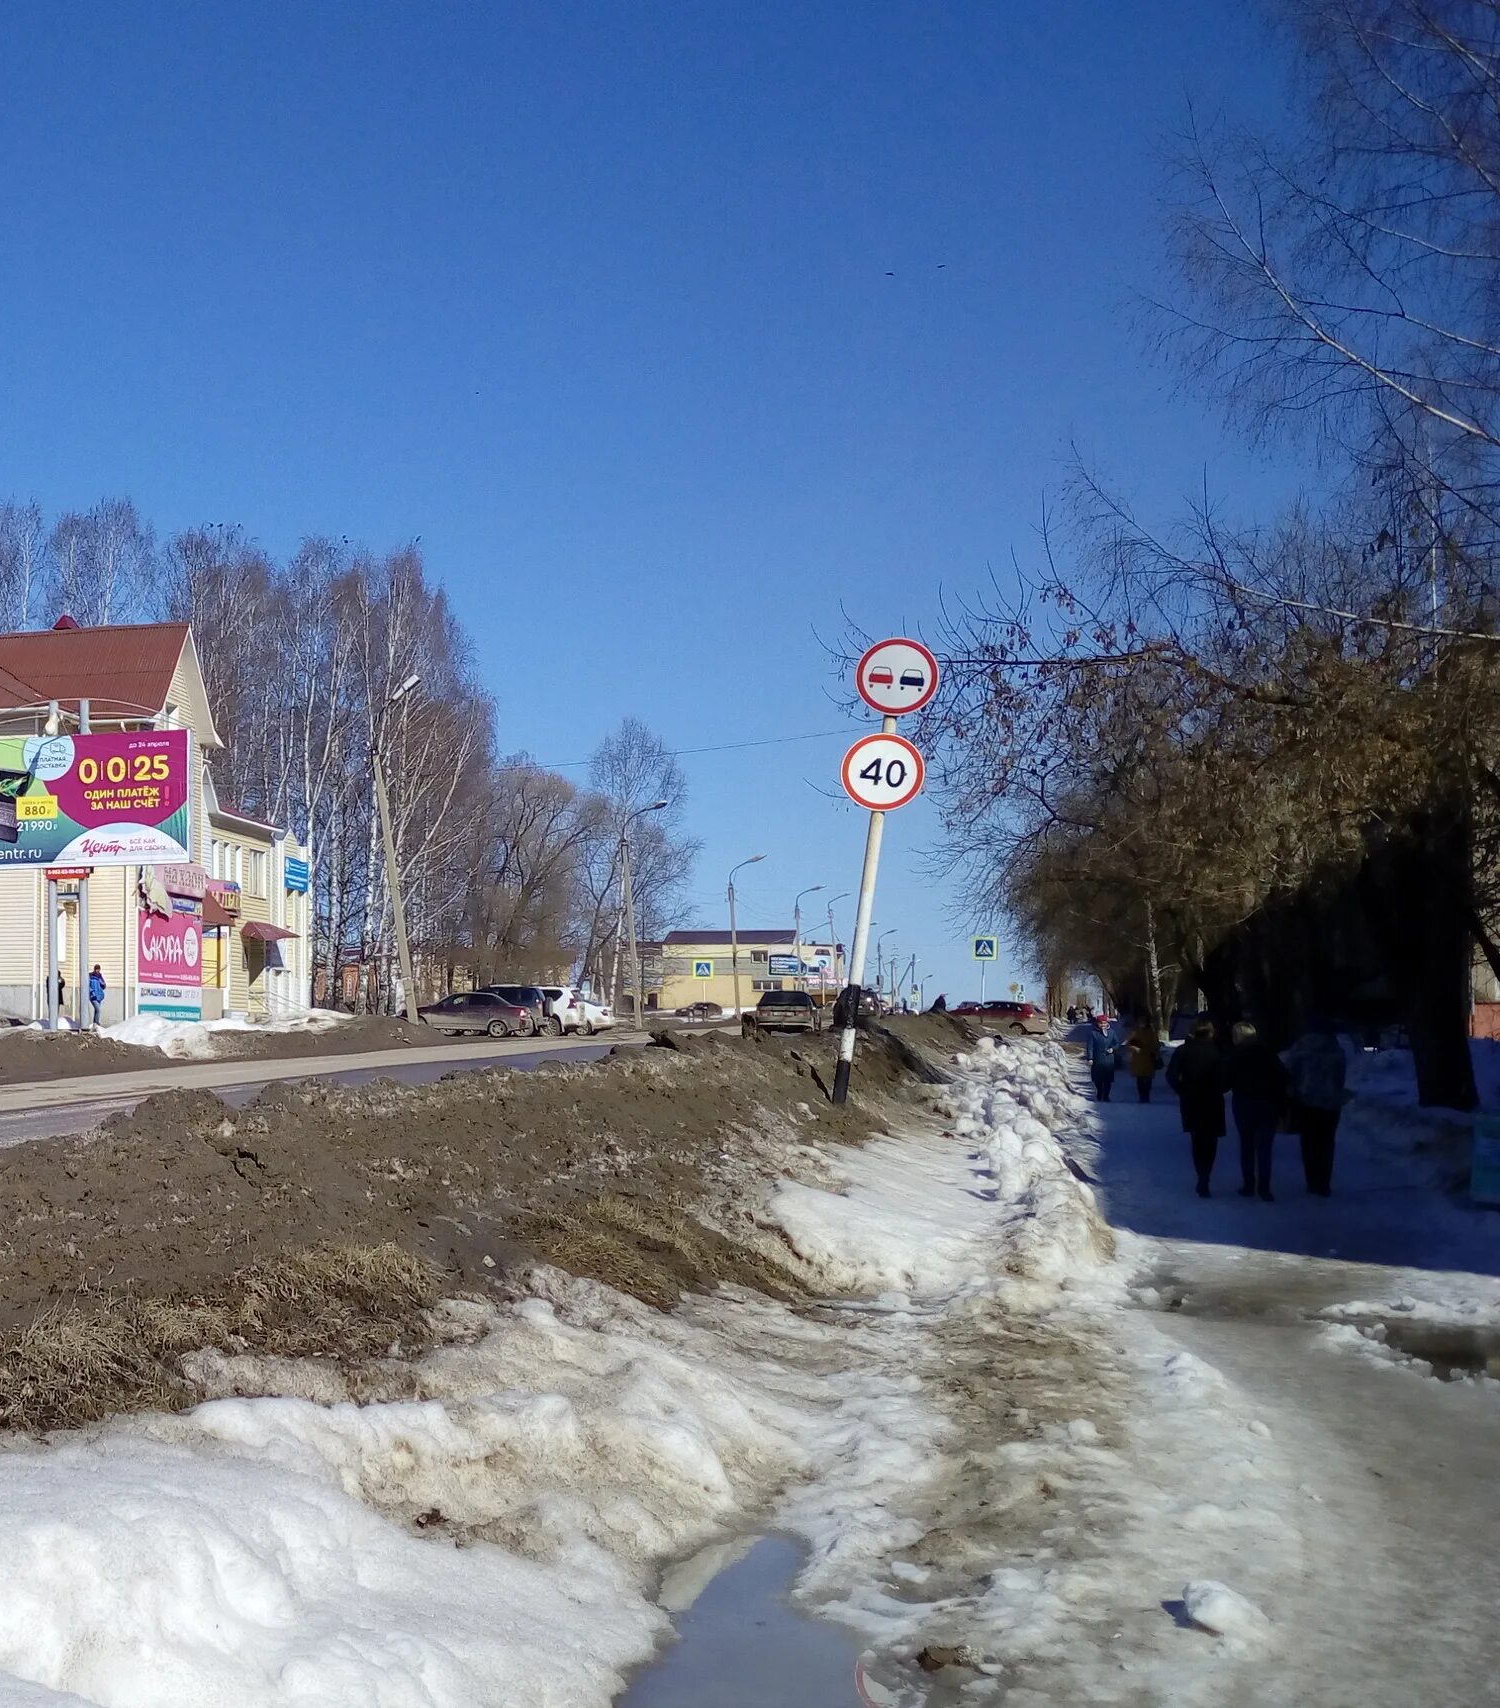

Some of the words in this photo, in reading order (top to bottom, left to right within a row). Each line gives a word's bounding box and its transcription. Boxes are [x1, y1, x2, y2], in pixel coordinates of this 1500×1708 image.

[860, 758, 906, 788] 40
[84, 790, 114, 799] ОДИН
[117, 786, 159, 797] ПЛАТЁЖ
[91, 801, 103, 810] ЗА
[106, 800, 131, 809] НАШ
[134, 797, 160, 808] СЧЁТ
[25, 806, 46, 816] 880
[80, 839, 127, 857] Центр
